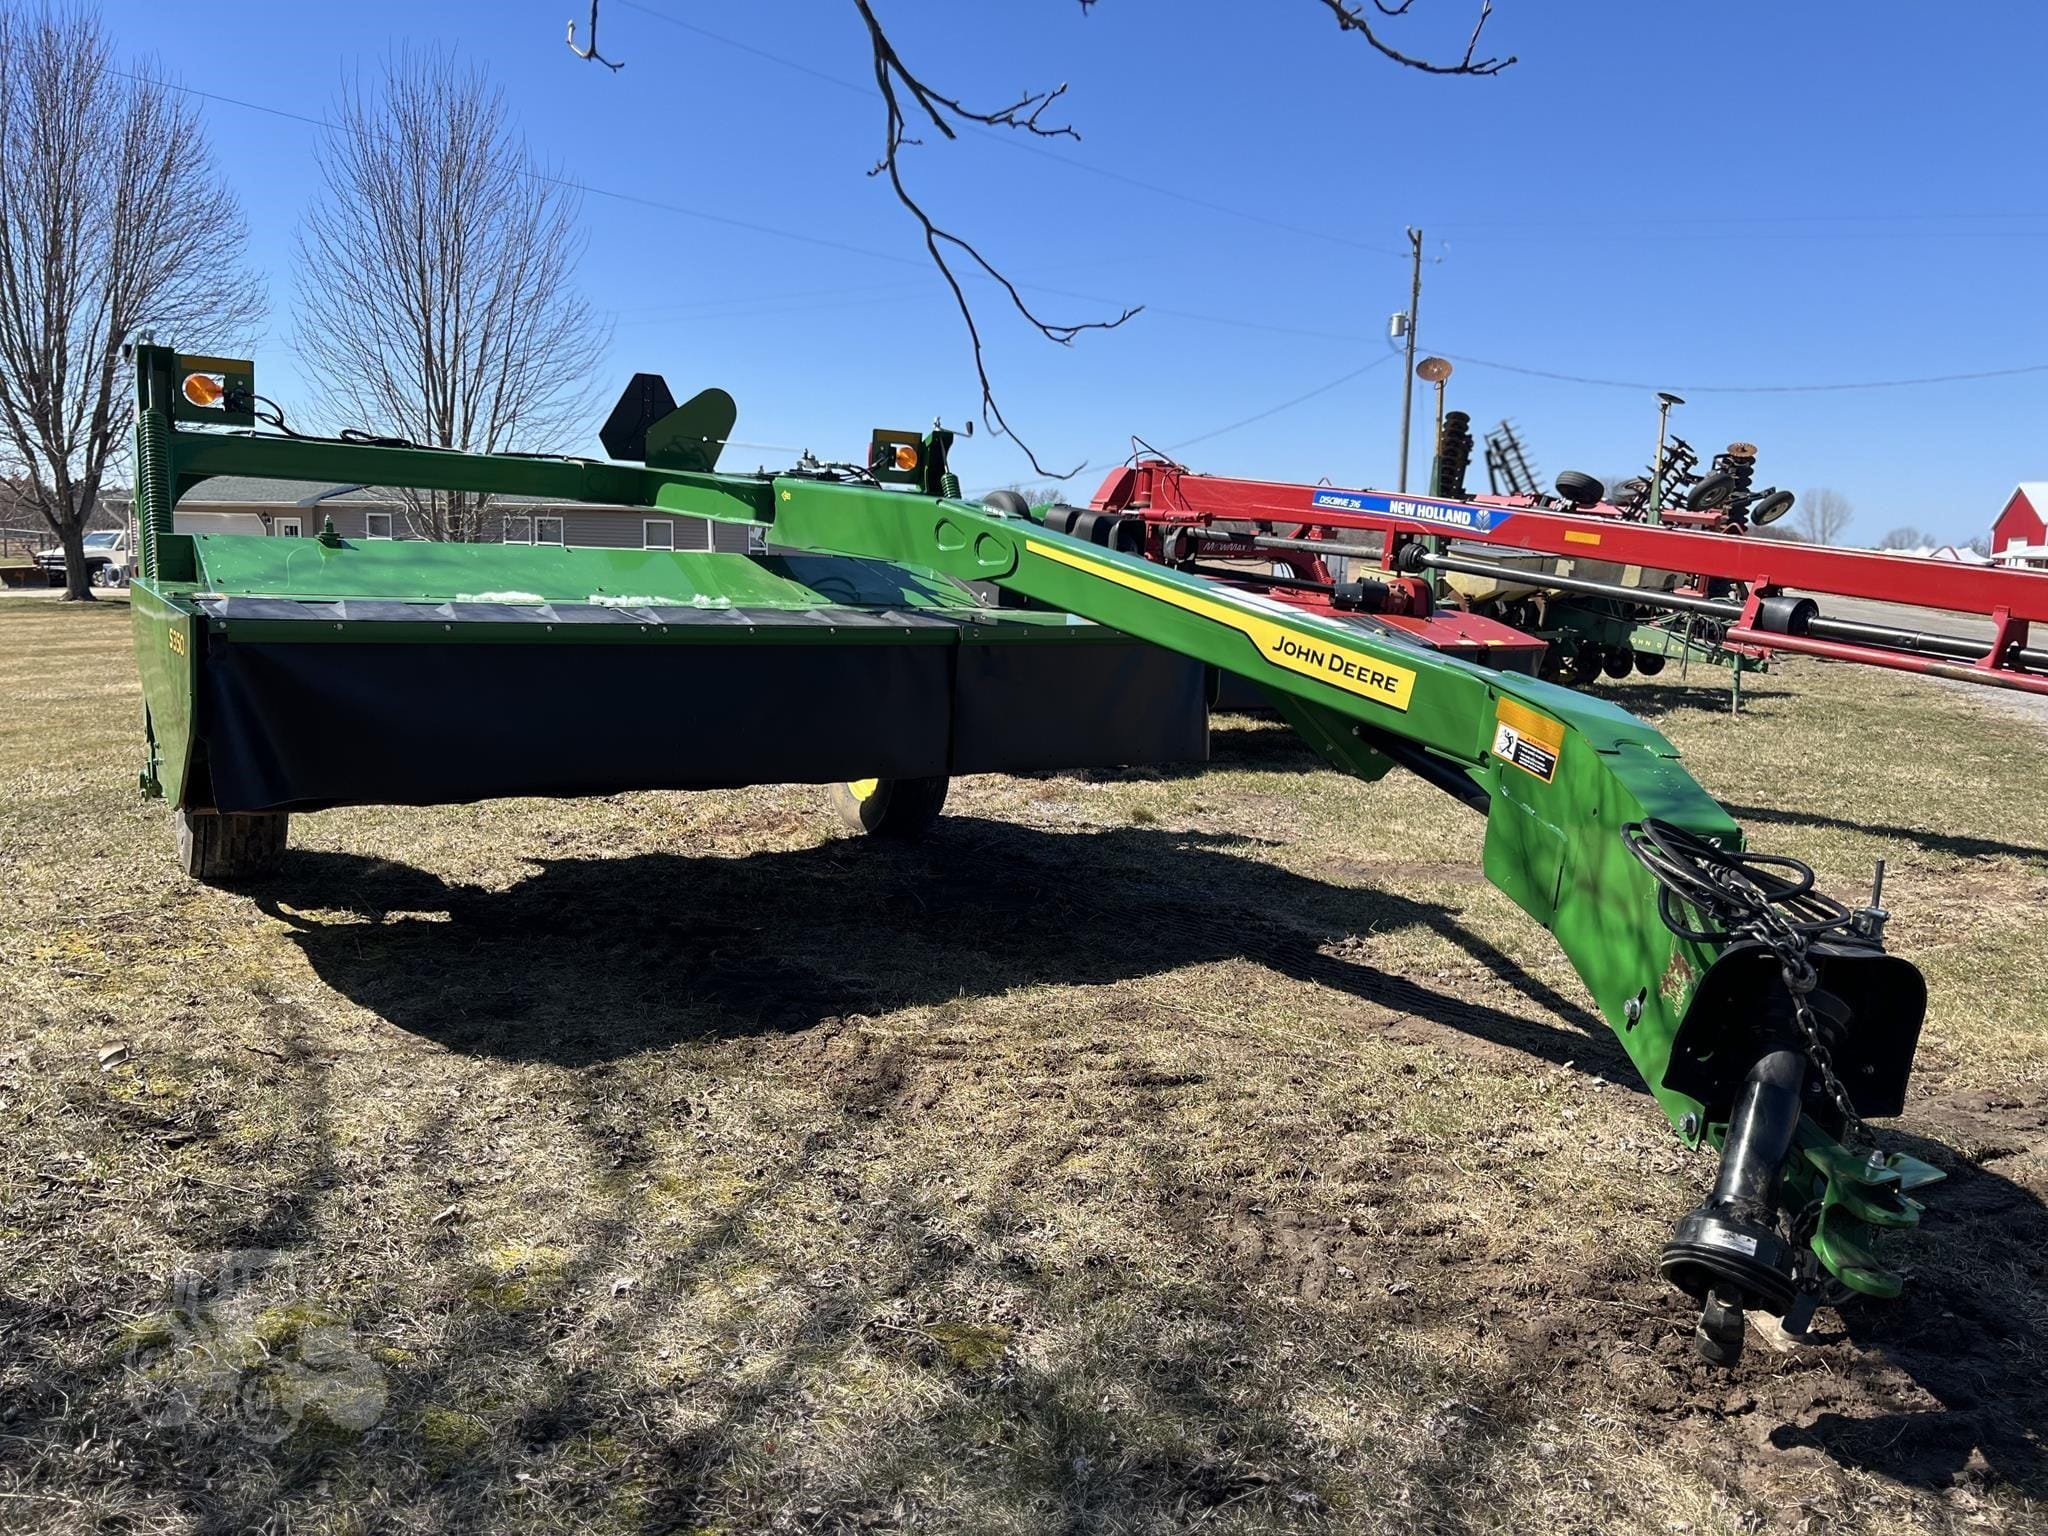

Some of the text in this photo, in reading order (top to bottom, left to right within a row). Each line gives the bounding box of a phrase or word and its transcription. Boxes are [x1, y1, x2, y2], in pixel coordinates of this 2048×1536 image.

[1389, 500, 1471, 525] NEW HOLLAND
[168, 626, 184, 656] S350
[1630, 637, 1685, 653] OHN DER
[1272, 635, 1399, 693] JOHN DEERE
